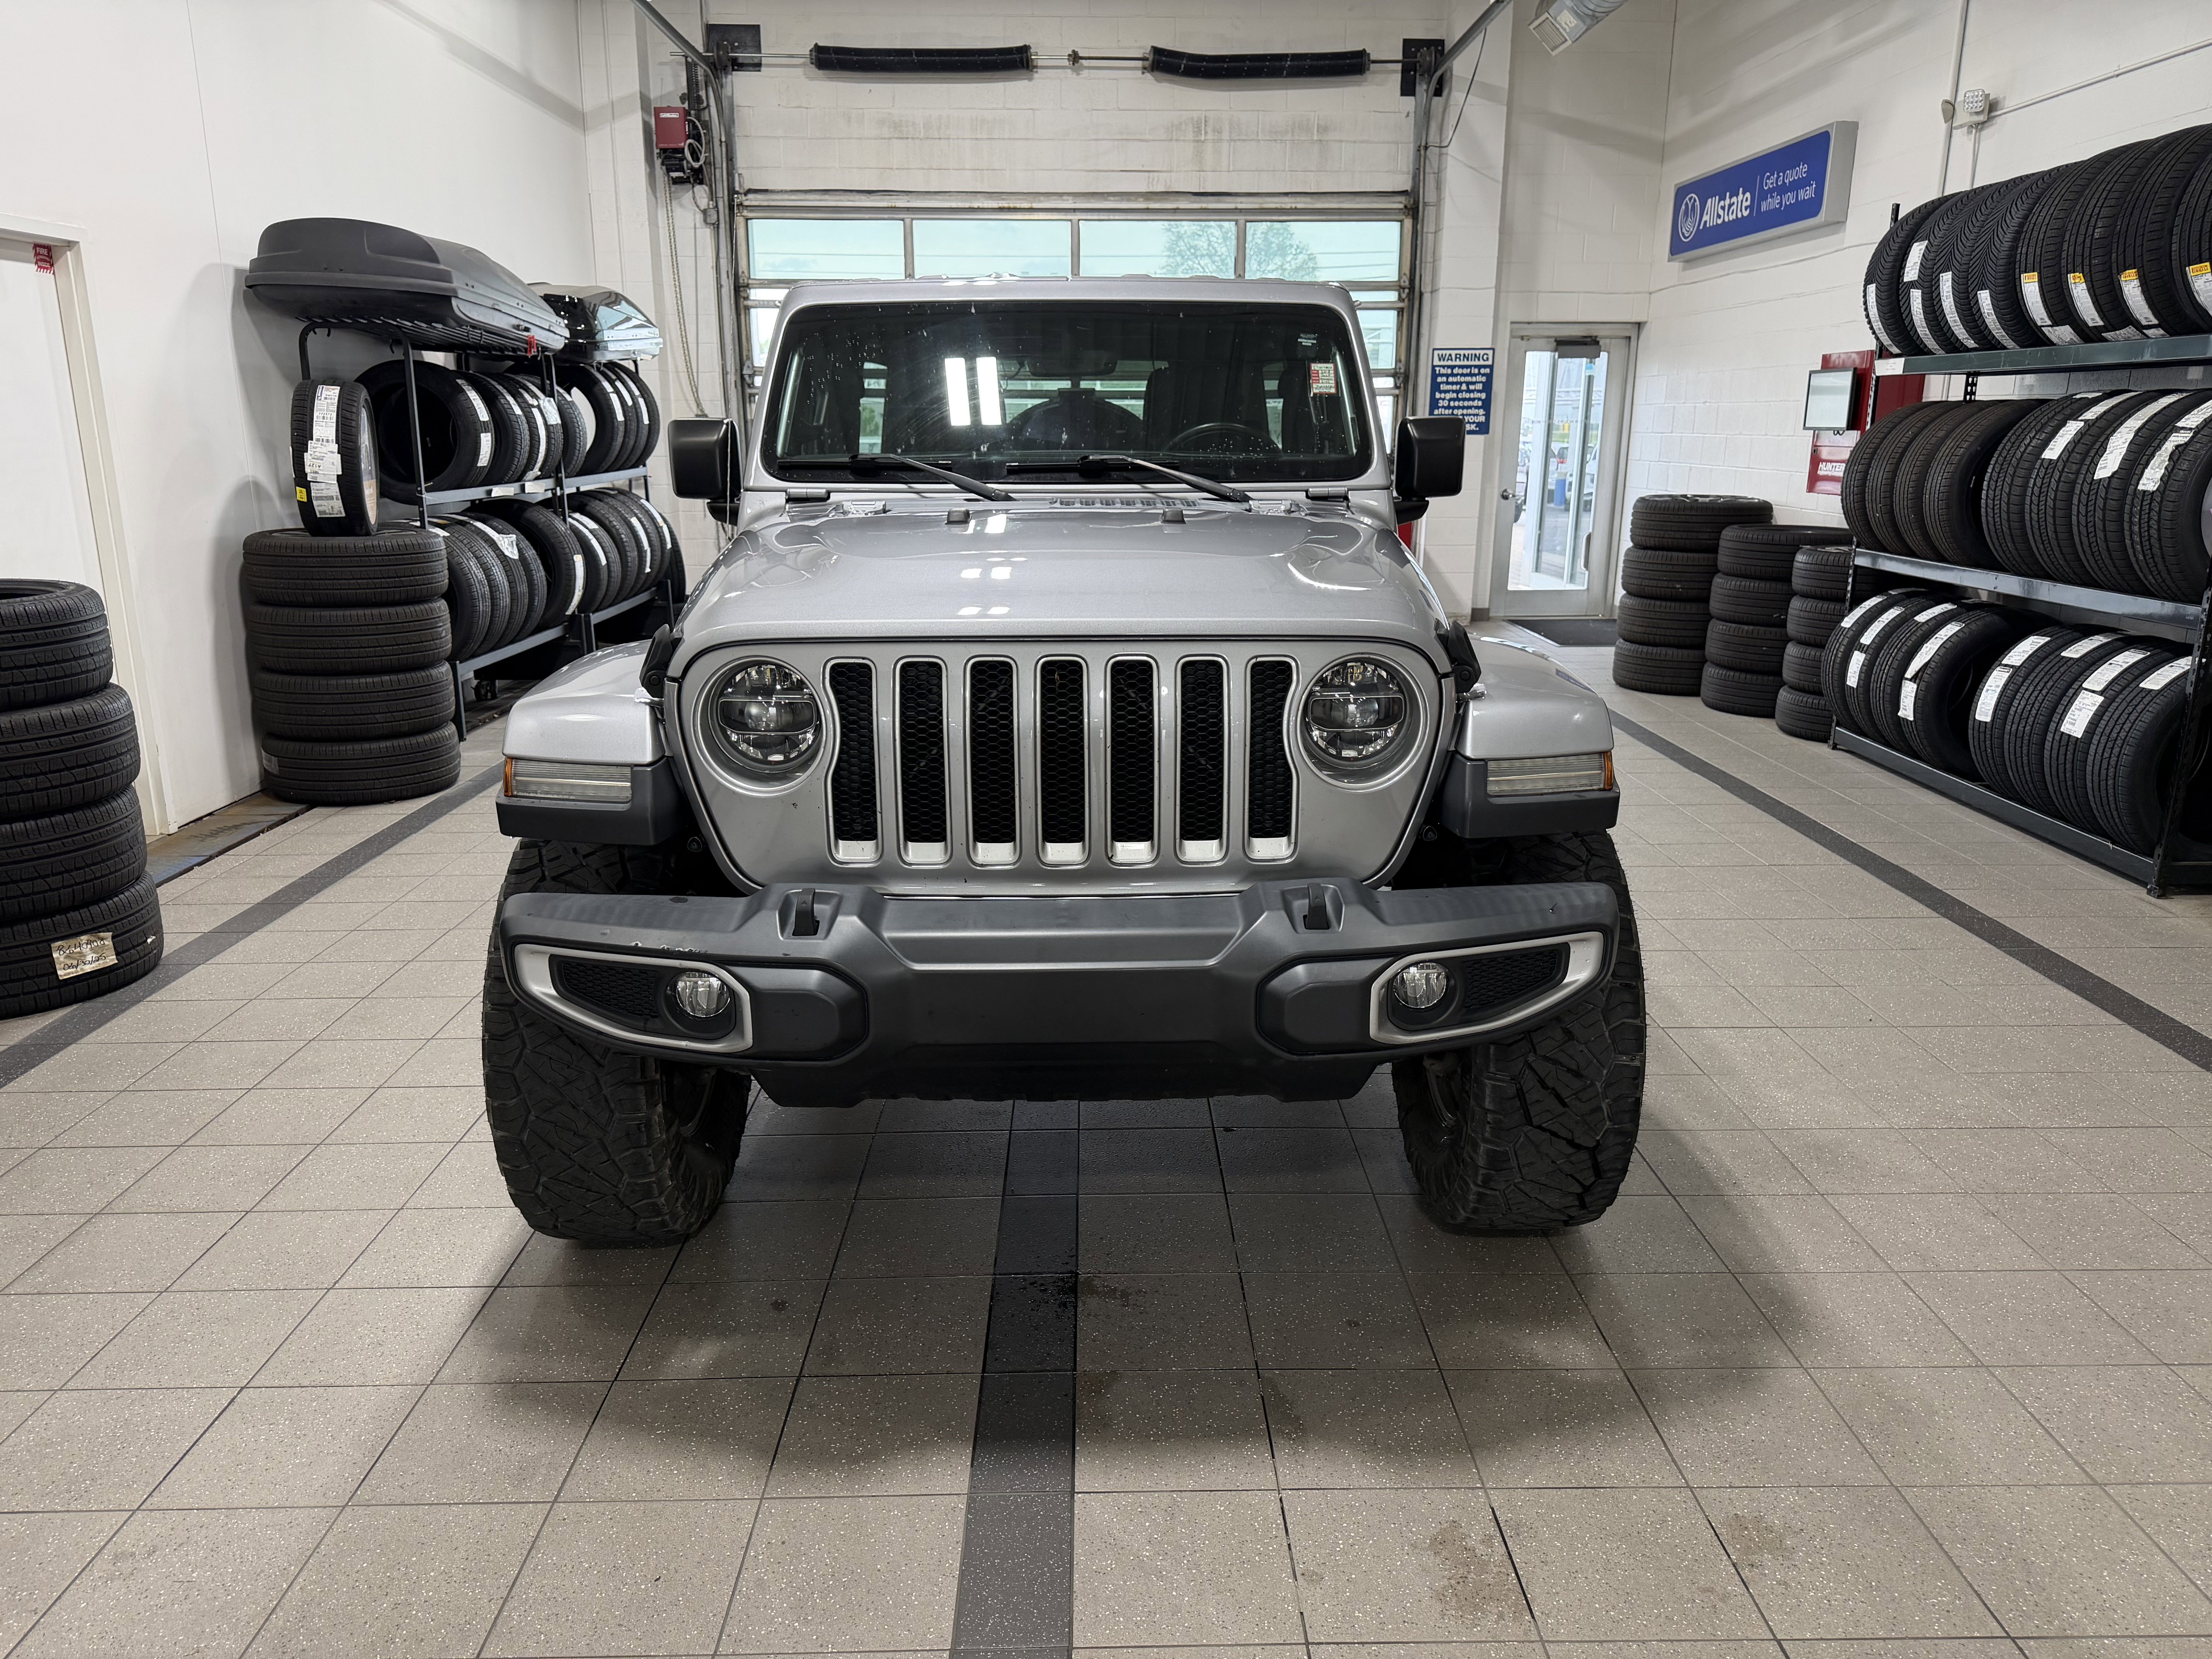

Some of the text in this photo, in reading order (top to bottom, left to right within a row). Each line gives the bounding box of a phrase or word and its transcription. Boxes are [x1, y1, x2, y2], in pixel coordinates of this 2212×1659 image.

[1763, 161, 1808, 190] Get a quote
[1761, 180, 1816, 212] while you wait
[1699, 187, 1751, 229] Allstate
[1437, 353, 1489, 362] WARNING
[1458, 391, 1486, 399] closing
[1818, 462, 1846, 472] HUNTER
[63, 952, 106, 970] 06/30/25
